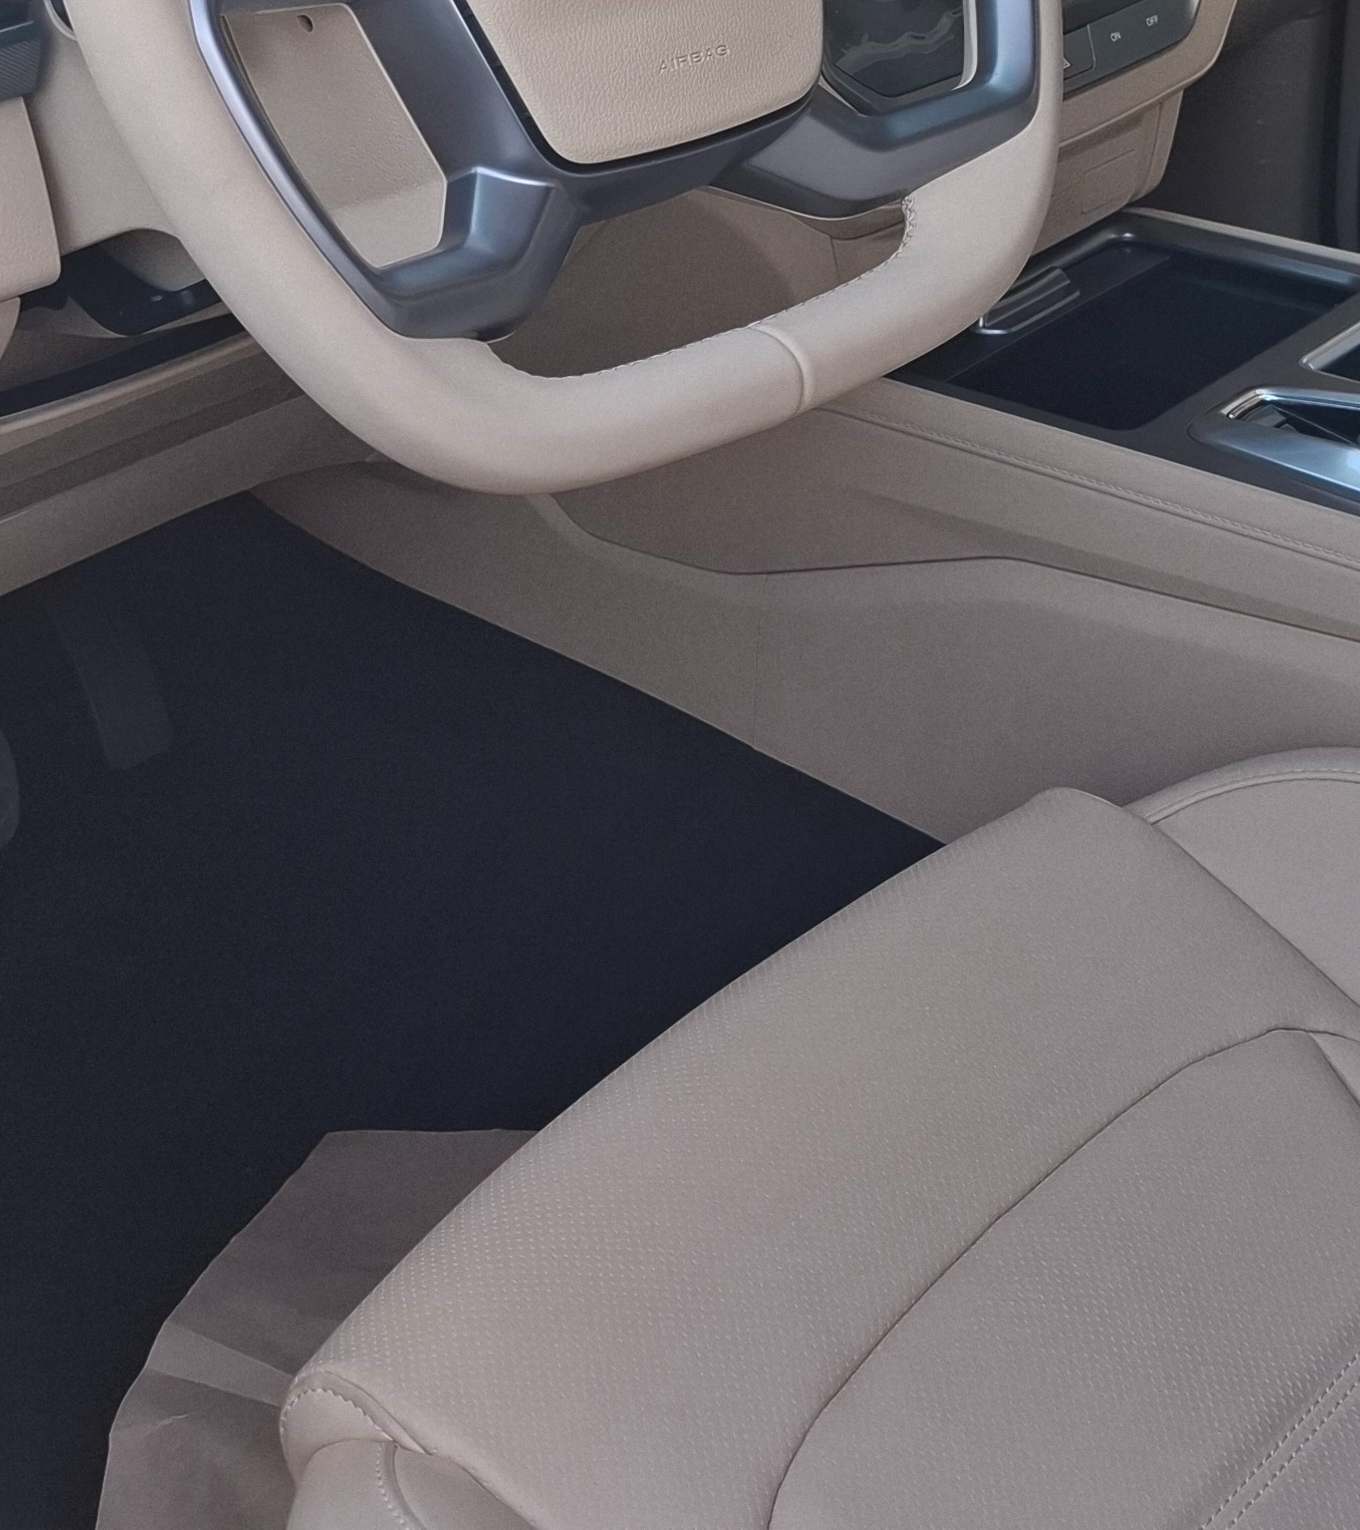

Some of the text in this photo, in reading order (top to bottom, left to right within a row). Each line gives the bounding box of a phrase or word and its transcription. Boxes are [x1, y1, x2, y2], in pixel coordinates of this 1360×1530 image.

[1145, 14, 1159, 27] OFF
[1110, 31, 1122, 42] ON
[658, 44, 730, 75] AIRBAG
